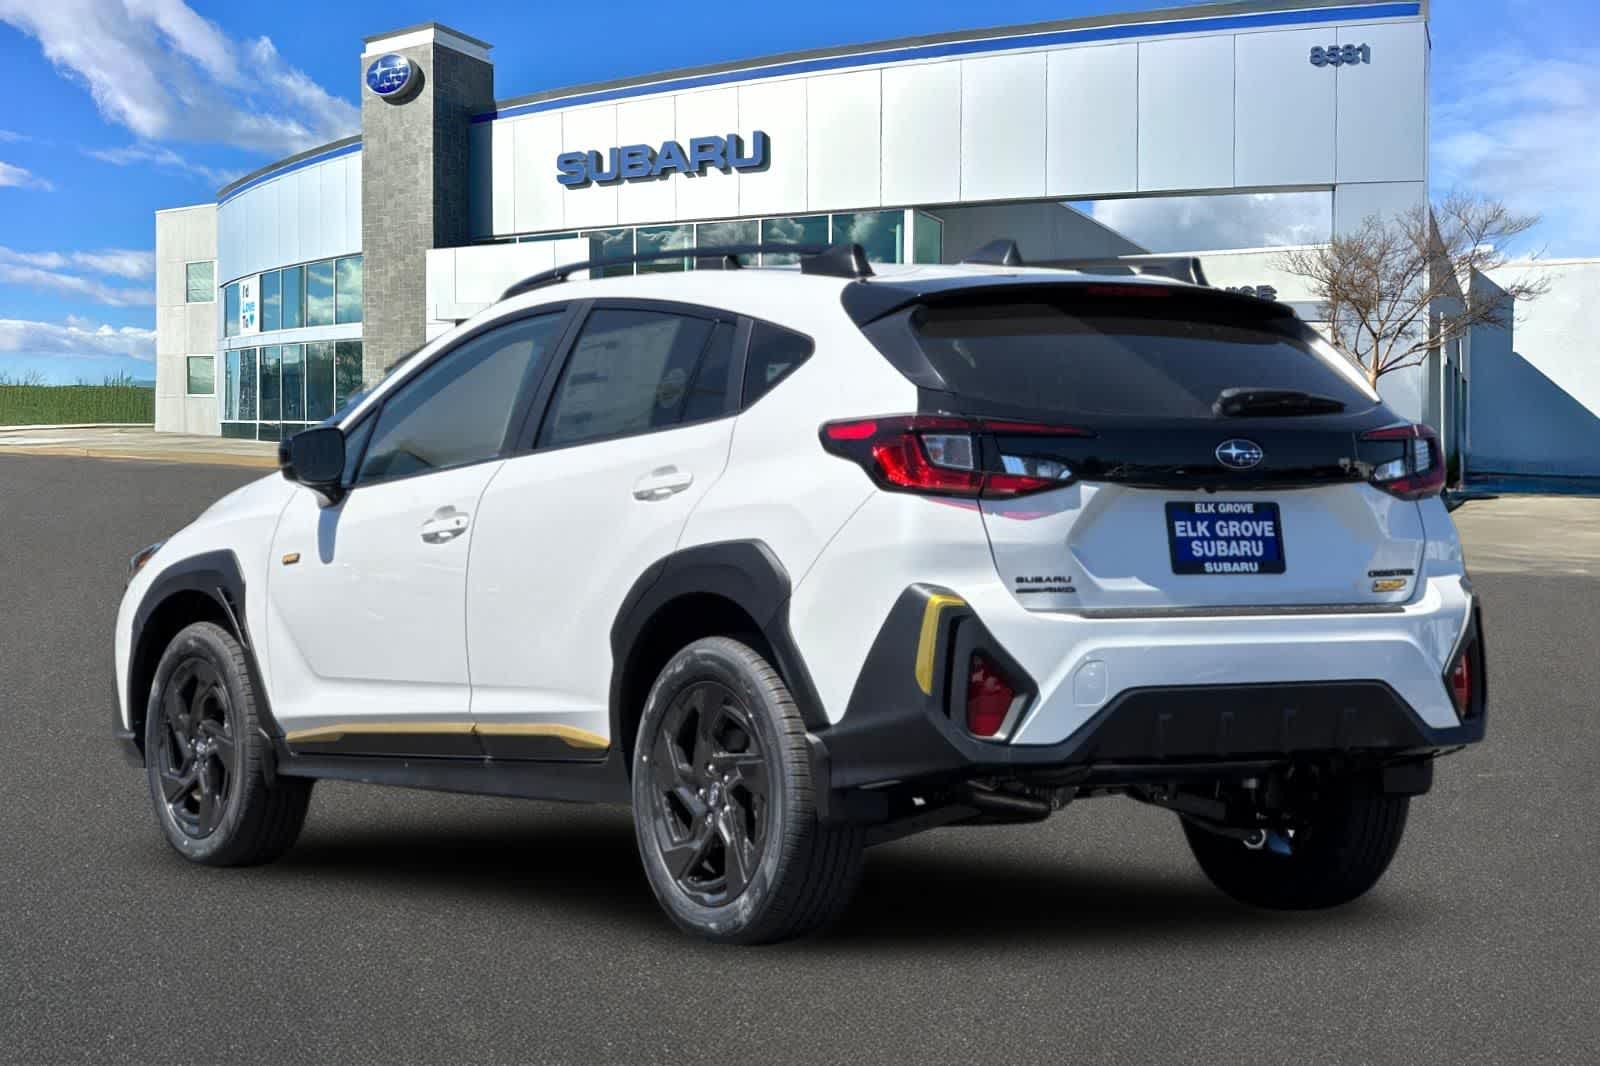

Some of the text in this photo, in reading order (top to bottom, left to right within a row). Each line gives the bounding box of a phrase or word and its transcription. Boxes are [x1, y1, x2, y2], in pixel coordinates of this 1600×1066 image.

[1310, 43, 1371, 67] 8581
[556, 130, 769, 187] SUBARU
[1195, 503, 1254, 513] ELK GROVE
[1175, 521, 1275, 537] ELK GROVE
[1191, 540, 1264, 556] SUBARU
[1204, 562, 1259, 572] SUBARU
[1015, 575, 1072, 584] SUBARU
